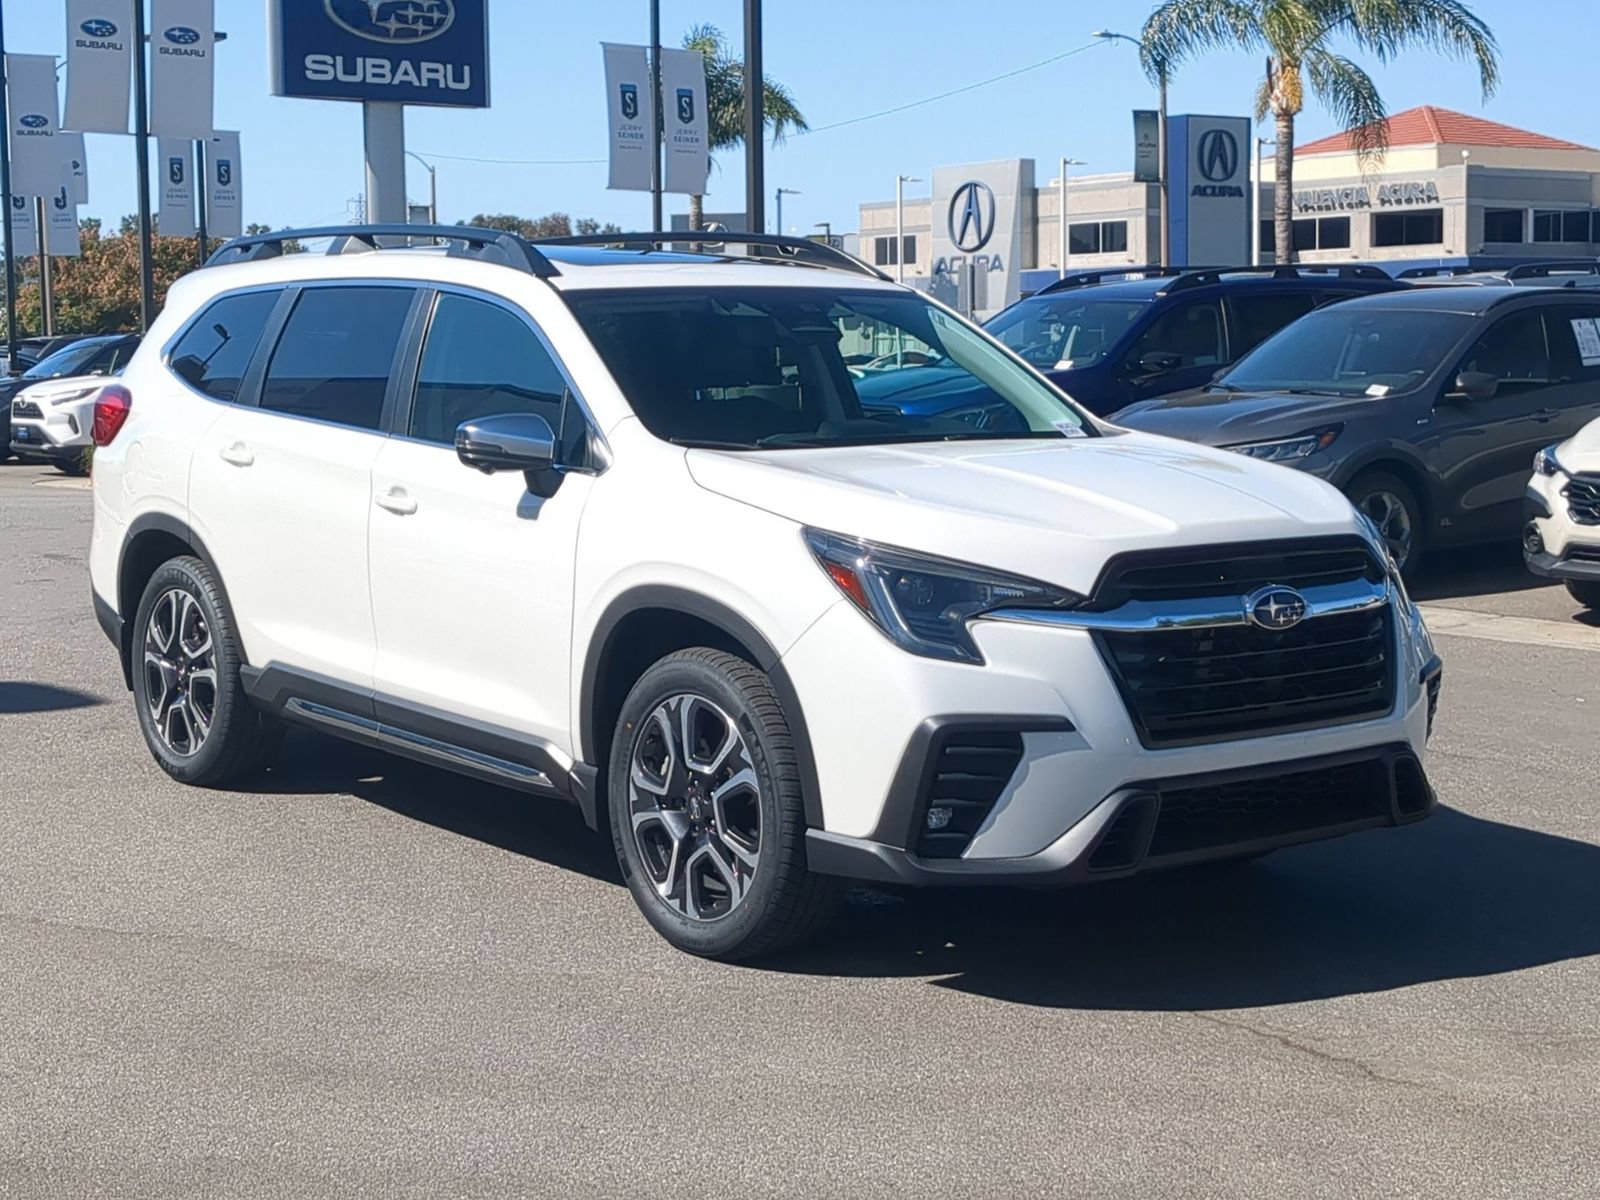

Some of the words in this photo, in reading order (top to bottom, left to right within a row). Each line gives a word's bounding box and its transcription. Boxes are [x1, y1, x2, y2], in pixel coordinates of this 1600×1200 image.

[75, 39, 123, 51] SUBARU
[159, 46, 206, 58] SUBARU
[304, 54, 470, 90] SUBARU
[16, 129, 54, 137] SUBARU
[617, 132, 644, 140] SEINER
[1190, 184, 1245, 198] ACURA
[1377, 181, 1437, 201] ACURA
